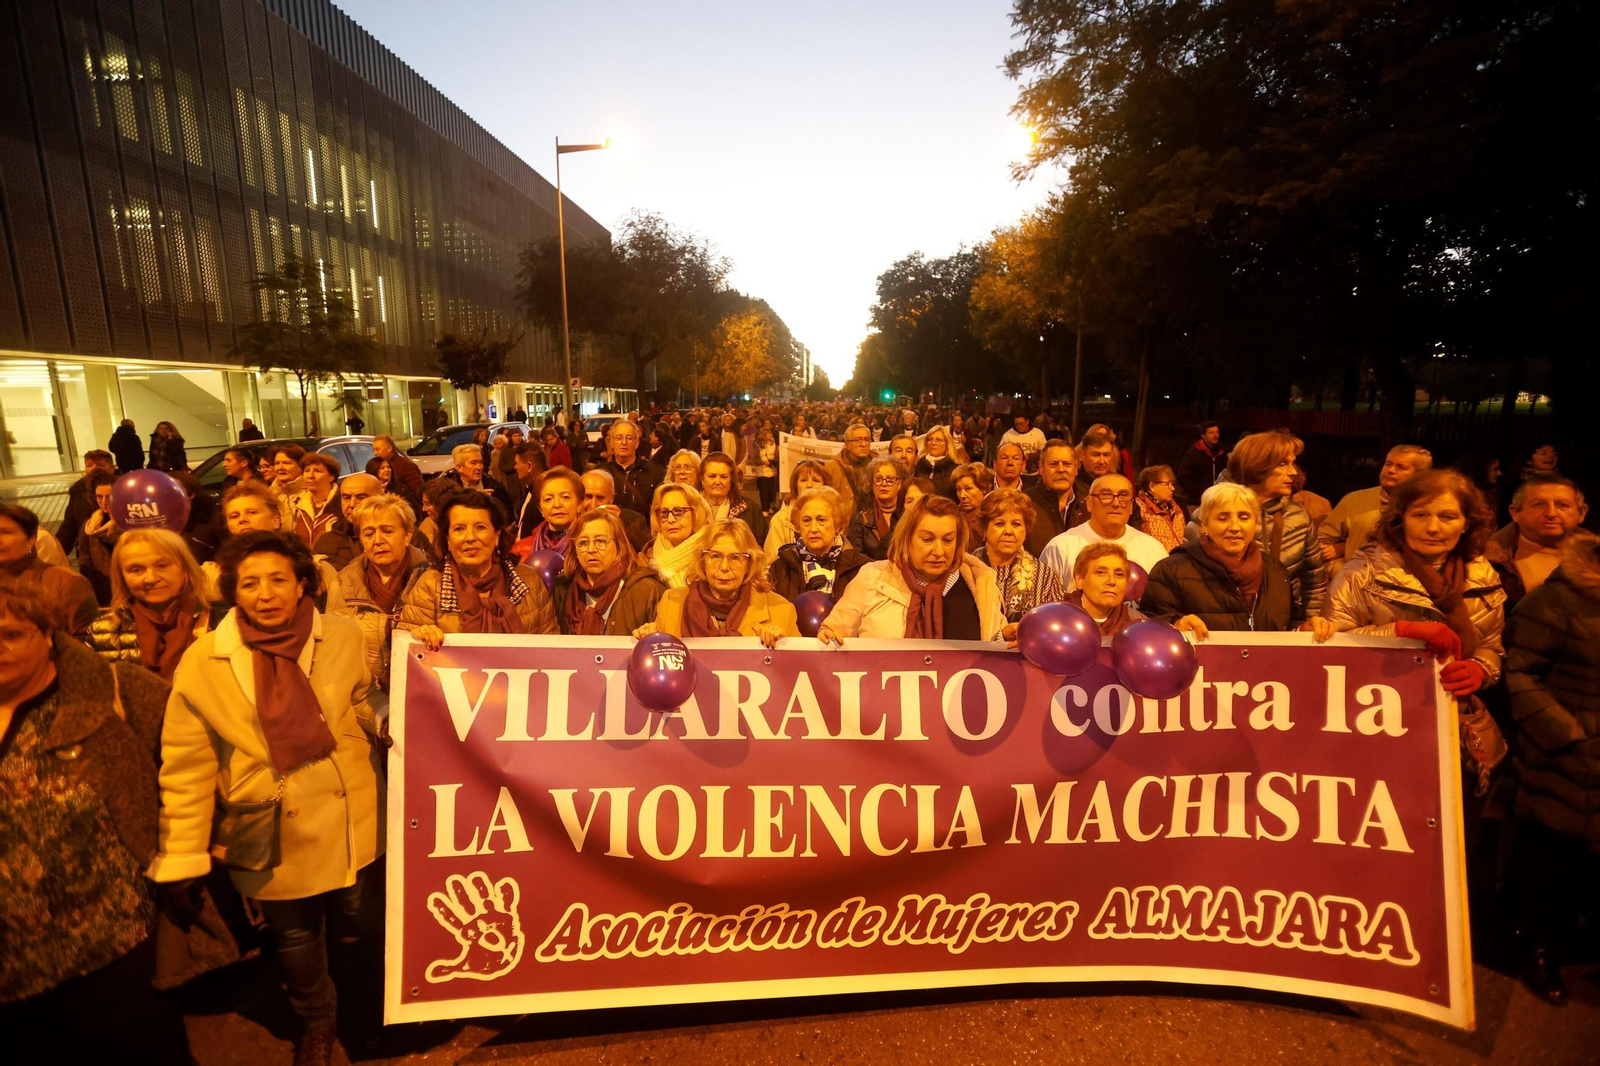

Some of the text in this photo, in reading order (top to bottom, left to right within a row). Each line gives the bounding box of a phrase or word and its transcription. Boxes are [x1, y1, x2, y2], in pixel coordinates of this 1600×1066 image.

[431, 665, 1409, 742] VILLARALTO contra la
[427, 771, 1415, 862] LA VIOLENCIA MACHISTA
[535, 885, 1421, 967] Asociación de Mujeres ALMAJARA
